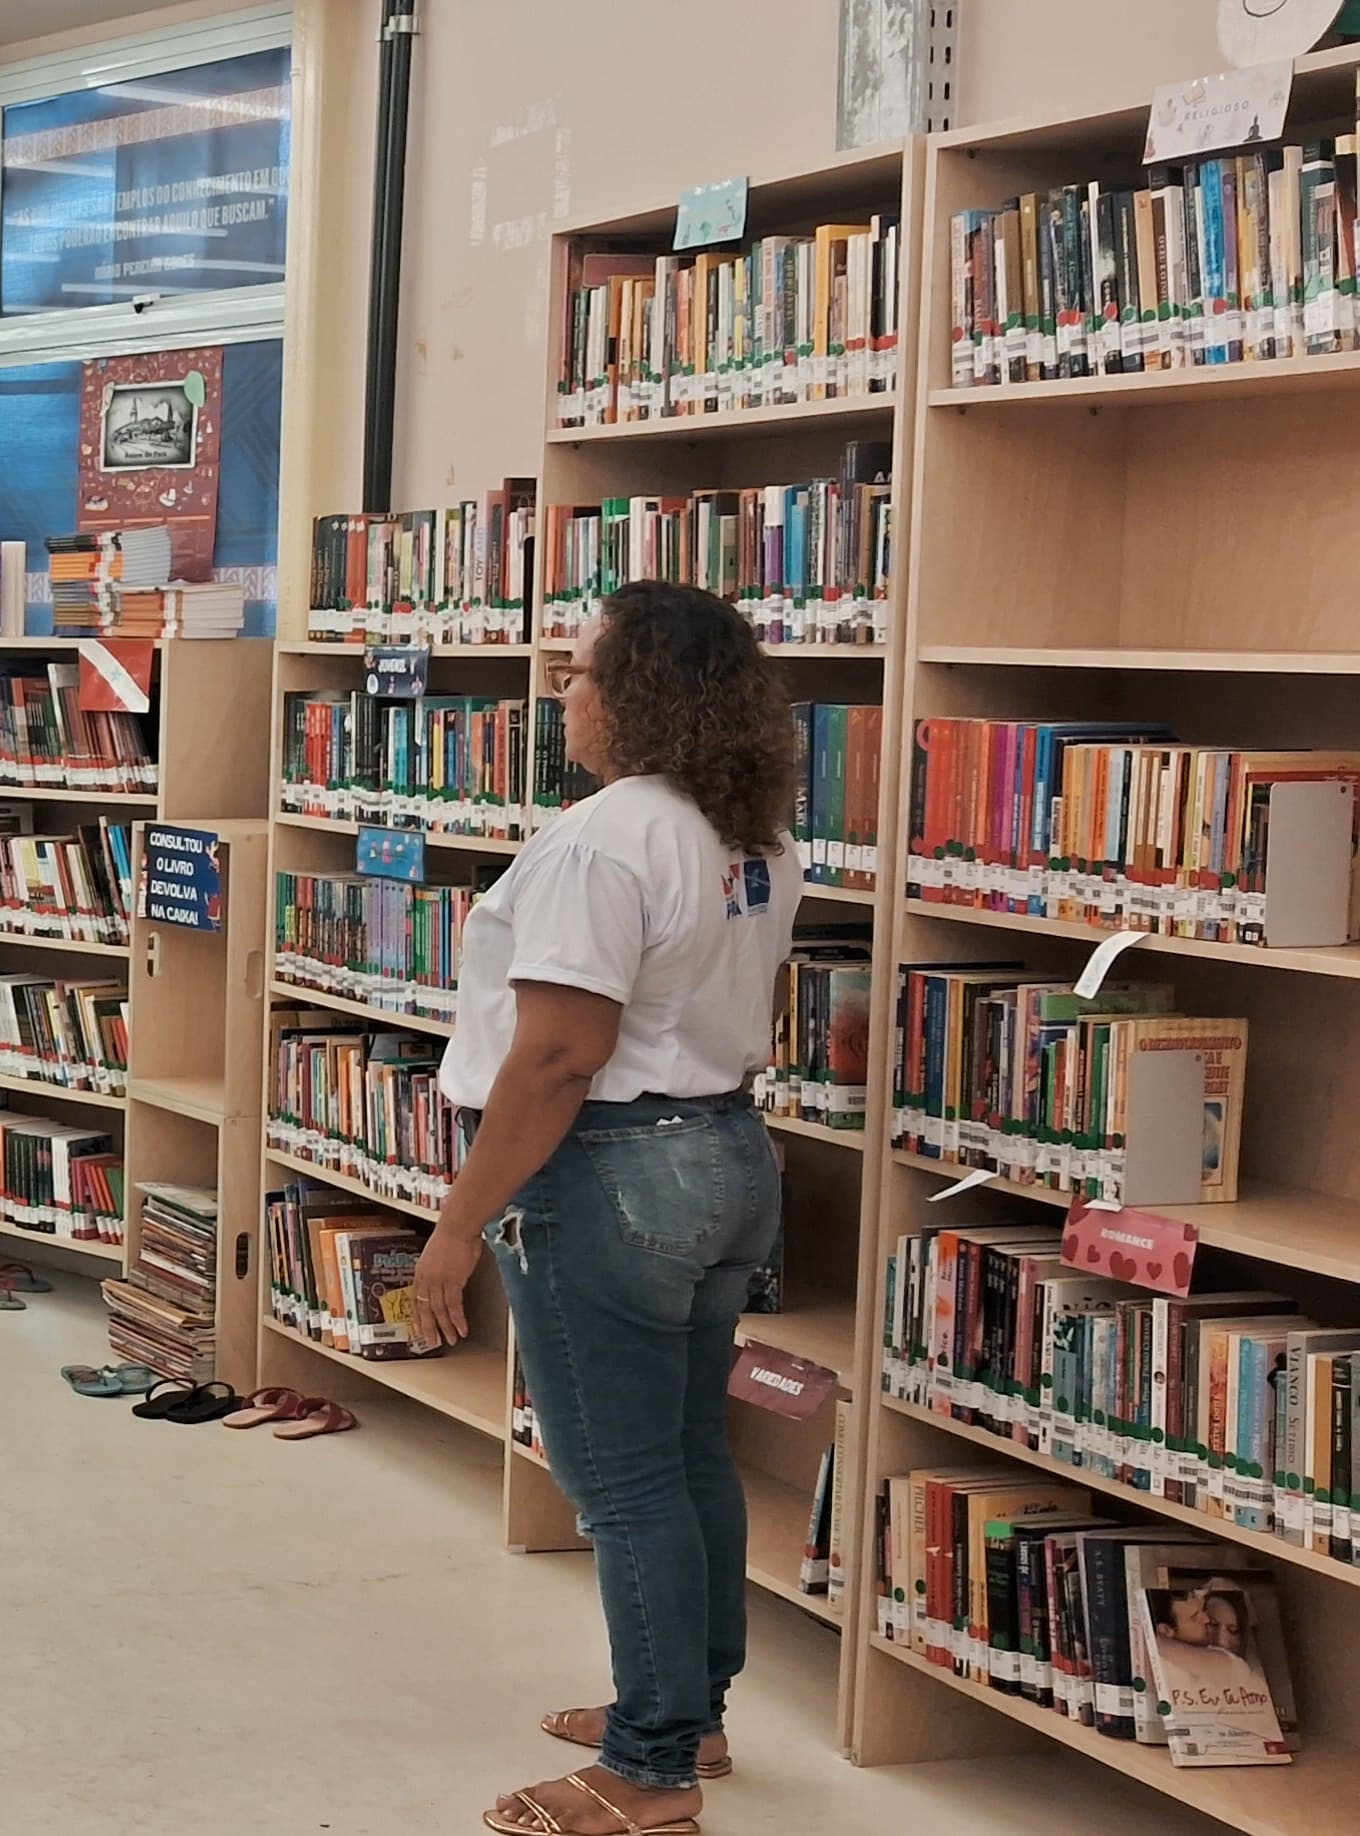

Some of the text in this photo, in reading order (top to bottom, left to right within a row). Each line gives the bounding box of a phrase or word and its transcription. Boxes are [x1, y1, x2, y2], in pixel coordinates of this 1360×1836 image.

[149, 832, 203, 854] CONSULTOU
[156, 857, 195, 877] O LIVRO
[150, 879, 199, 902] DEVOLVA
[150, 902, 166, 920] NA
[1101, 1228, 1154, 1250] ROMANCE
[750, 1366, 805, 1397] VARIEDADES
[913, 1485, 925, 1535] PILCHER
[1171, 1689, 1199, 1706] P.S.
[1199, 1687, 1221, 1705] Eu
